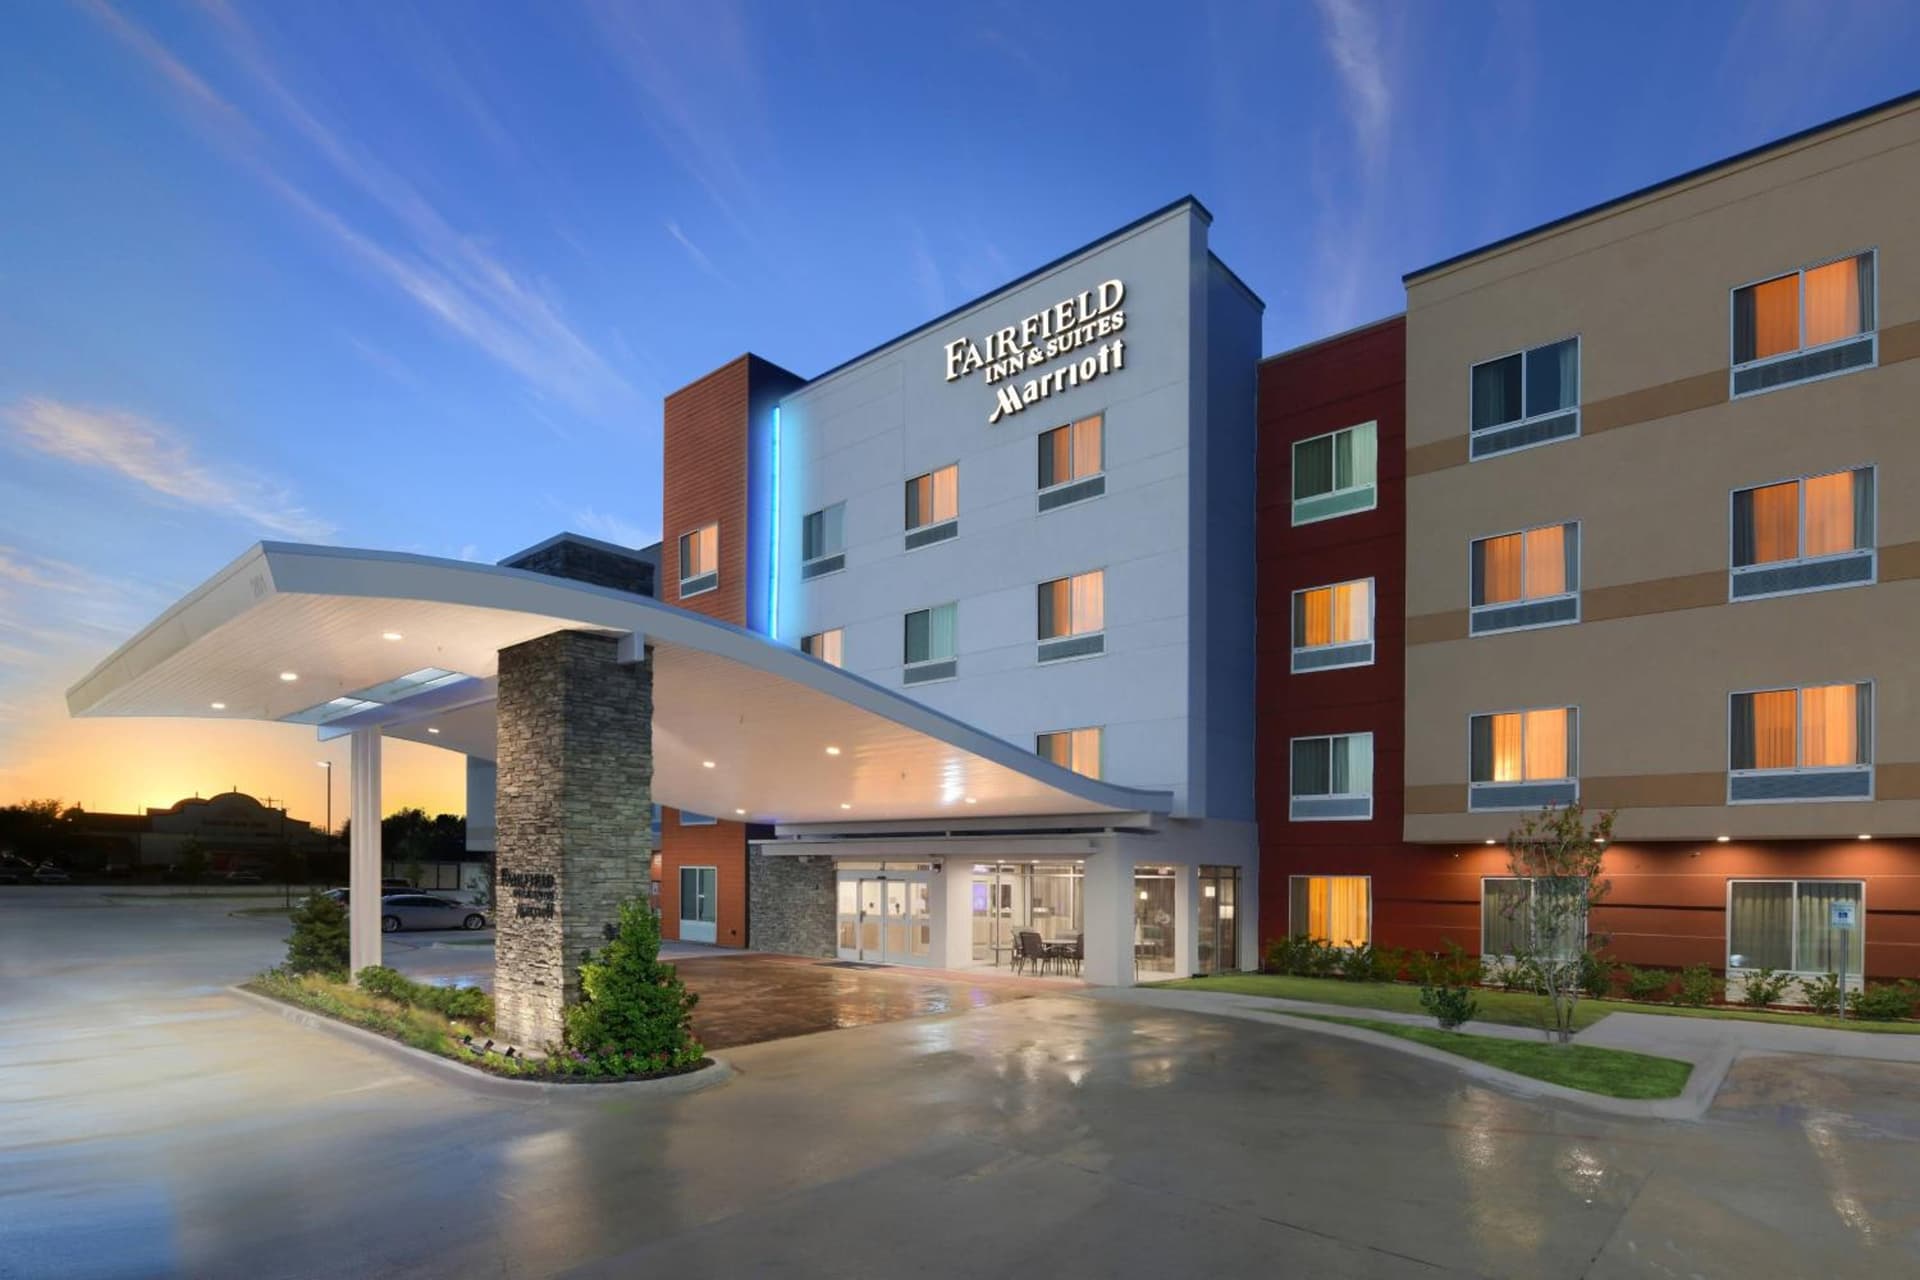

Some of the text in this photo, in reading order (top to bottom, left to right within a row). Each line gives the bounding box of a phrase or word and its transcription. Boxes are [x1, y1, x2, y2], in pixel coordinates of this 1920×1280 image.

[944, 279, 1125, 381] FAIRFIELD
[985, 353, 1025, 384] INN
[1046, 310, 1125, 358] SUITES
[988, 339, 1124, 423] Marriott
